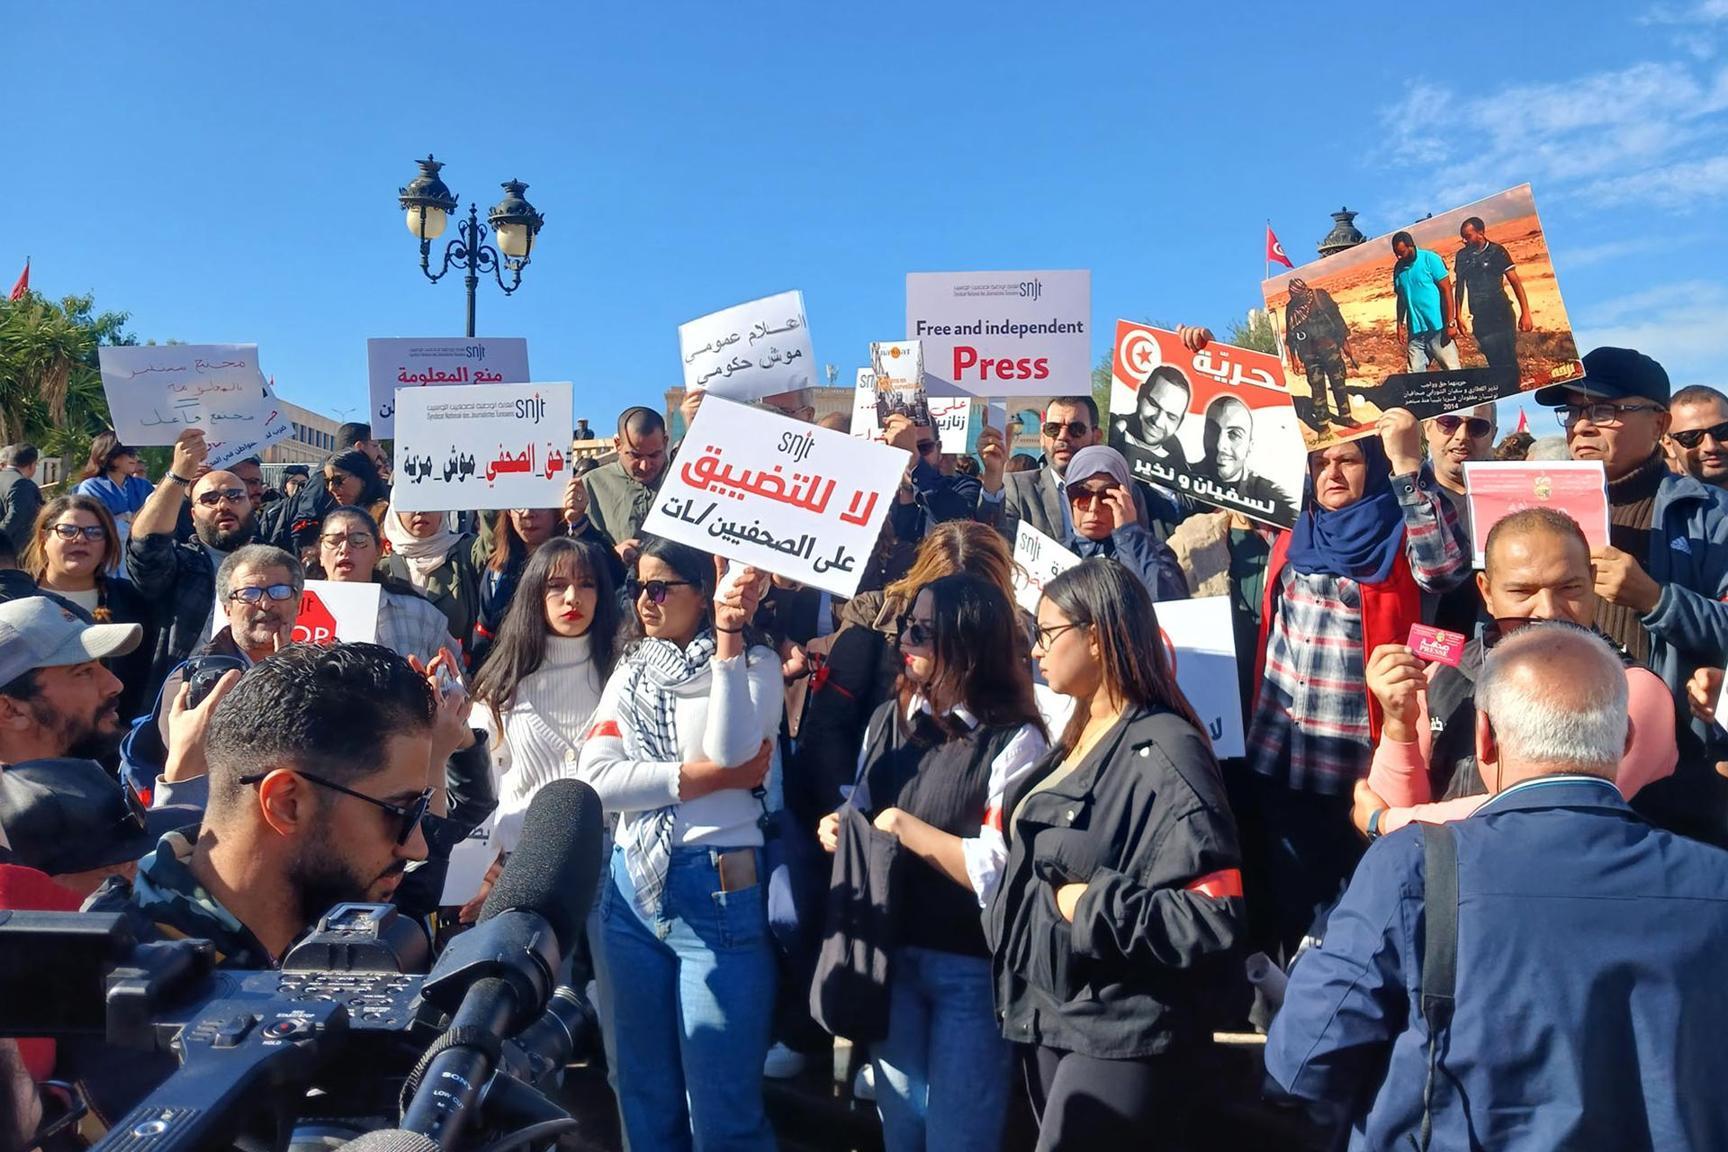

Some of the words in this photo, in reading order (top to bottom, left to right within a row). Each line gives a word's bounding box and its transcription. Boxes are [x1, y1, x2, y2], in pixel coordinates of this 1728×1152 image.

[1019, 278, 1042, 301] snjt
[916, 320, 951, 336] Free
[954, 319, 982, 335] and
[985, 318, 1084, 338] independent
[465, 343, 485, 361] snjt
[953, 346, 1049, 381] Press
[397, 366, 469, 386] المعلومة
[696, 356, 753, 386] حكومي
[515, 392, 546, 424] snjt
[777, 430, 816, 463] snjt
[681, 445, 837, 515] للتضييق
[1178, 472, 1191, 489] و
[839, 490, 879, 528] لا
[1193, 476, 1276, 515] لسفيان
[813, 546, 856, 574] على
[1020, 532, 1042, 562] snjt
[433, 1089, 452, 1099] LOW
[442, 1071, 473, 1091] SONY
